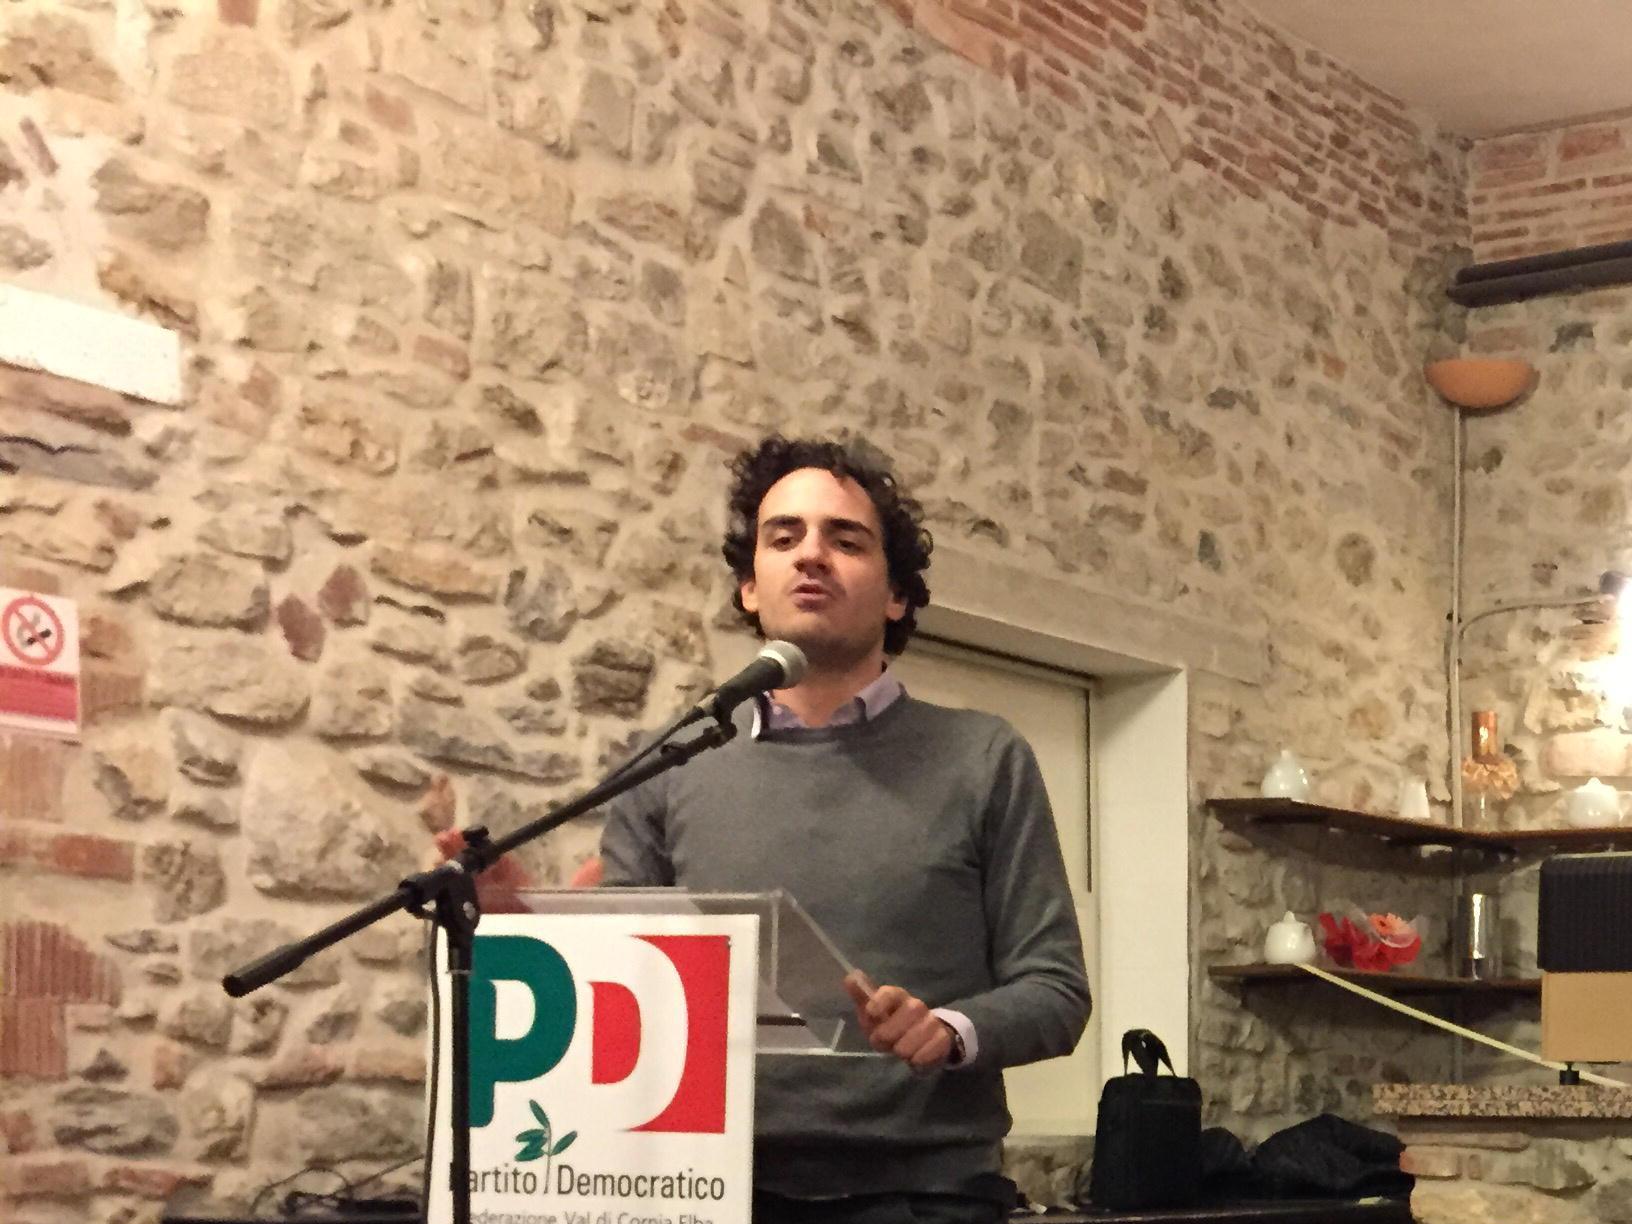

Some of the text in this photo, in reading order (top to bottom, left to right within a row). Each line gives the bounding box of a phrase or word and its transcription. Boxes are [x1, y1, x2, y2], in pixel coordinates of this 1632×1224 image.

[466, 934, 690, 1132] PD
[450, 1163, 725, 1201] artito Democratico
